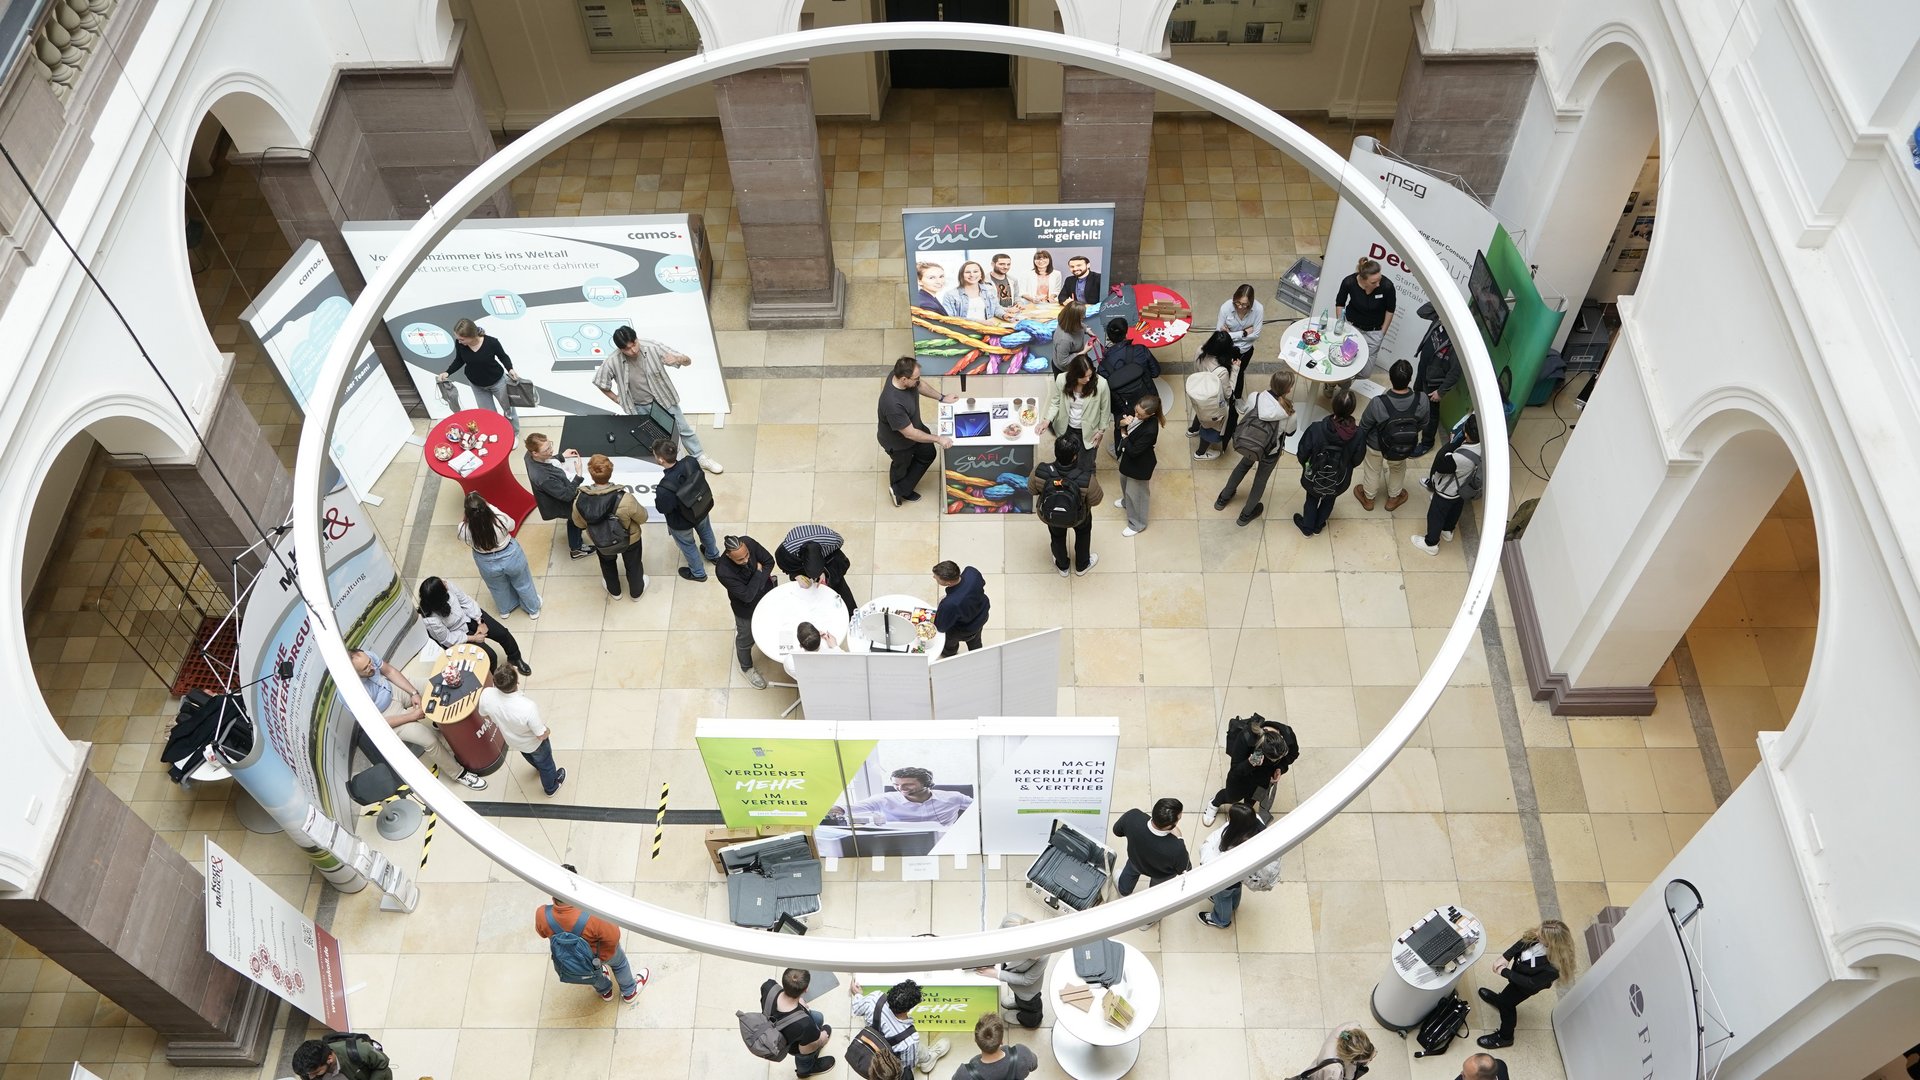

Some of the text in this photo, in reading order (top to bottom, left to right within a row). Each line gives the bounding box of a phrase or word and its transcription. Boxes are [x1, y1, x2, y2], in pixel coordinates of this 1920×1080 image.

[942, 223, 967, 233] AFI
[1034, 217, 1105, 228] Du hast uns
[1044, 227, 1067, 235] gerade
[1055, 230, 1102, 243] gefehlt!
[369, 249, 569, 262] Vo nzimmer bis ins Weltall
[430, 264, 470, 273] unsere
[471, 261, 550, 273] CPQ-Software
[552, 260, 601, 271] dahinter
[1395, 273, 1420, 292] Starte
[354, 363, 371, 384] Team!
[977, 453, 999, 461] AFI
[261, 679, 281, 757] EINFACH
[735, 778, 806, 793] MEHR
[916, 1003, 969, 1014] EHR
